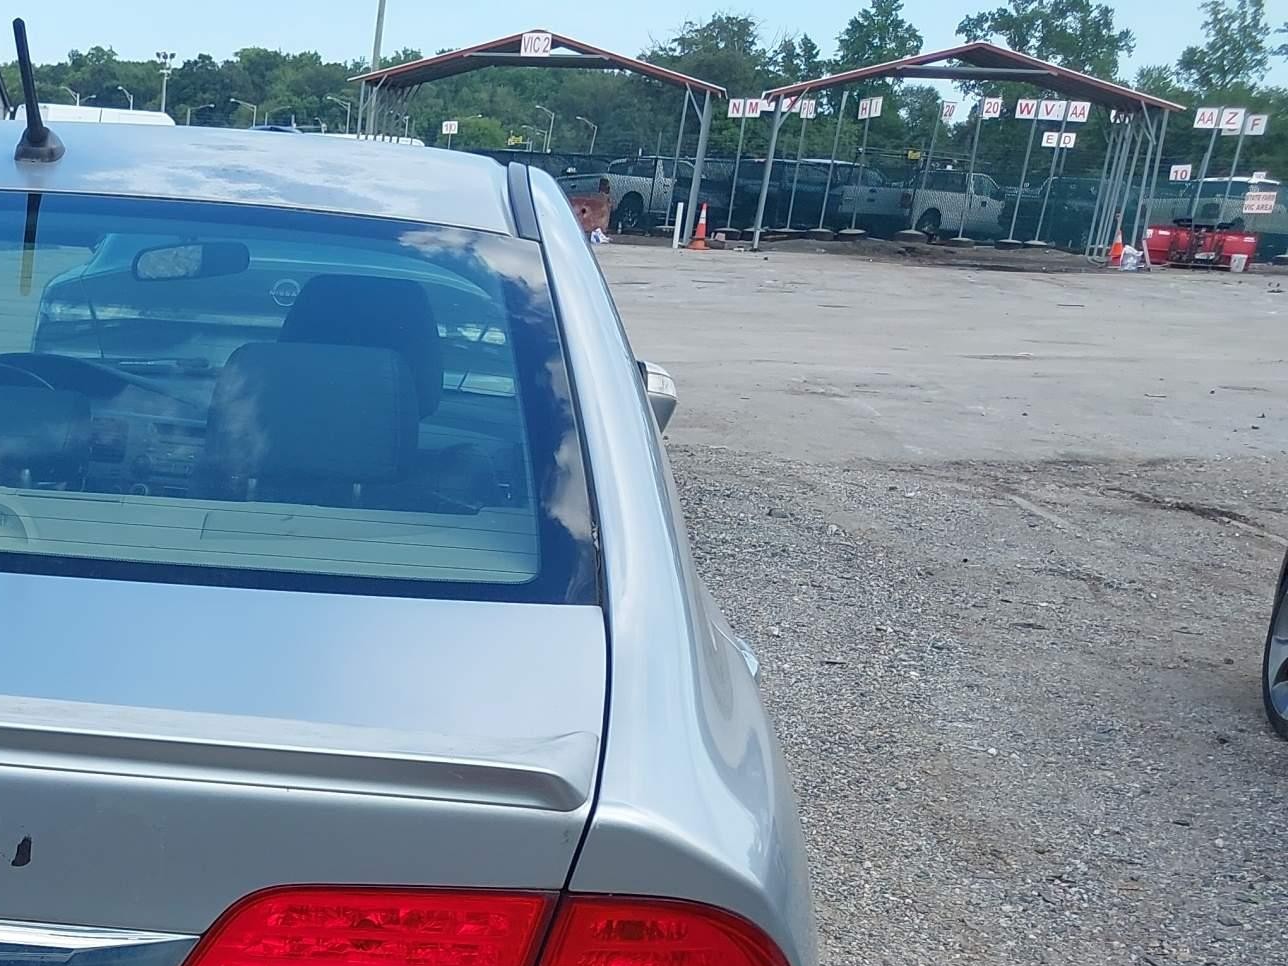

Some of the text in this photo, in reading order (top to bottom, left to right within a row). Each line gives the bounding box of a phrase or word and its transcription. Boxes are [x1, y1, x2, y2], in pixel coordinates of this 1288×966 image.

[523, 36, 550, 53] VIC 2
[732, 101, 741, 114] N
[748, 101, 759, 114] M
[861, 103, 867, 116] H
[944, 104, 955, 117] 20
[985, 101, 999, 114] 20
[1019, 102, 1035, 115] W
[1045, 103, 1056, 116] V
[1070, 105, 1086, 118] AA
[1197, 111, 1214, 124] AA
[1225, 112, 1239, 125] Z
[1250, 118, 1262, 131] F
[1046, 134, 1054, 144] E
[1062, 135, 1072, 145] D
[1174, 169, 1188, 180] 10
